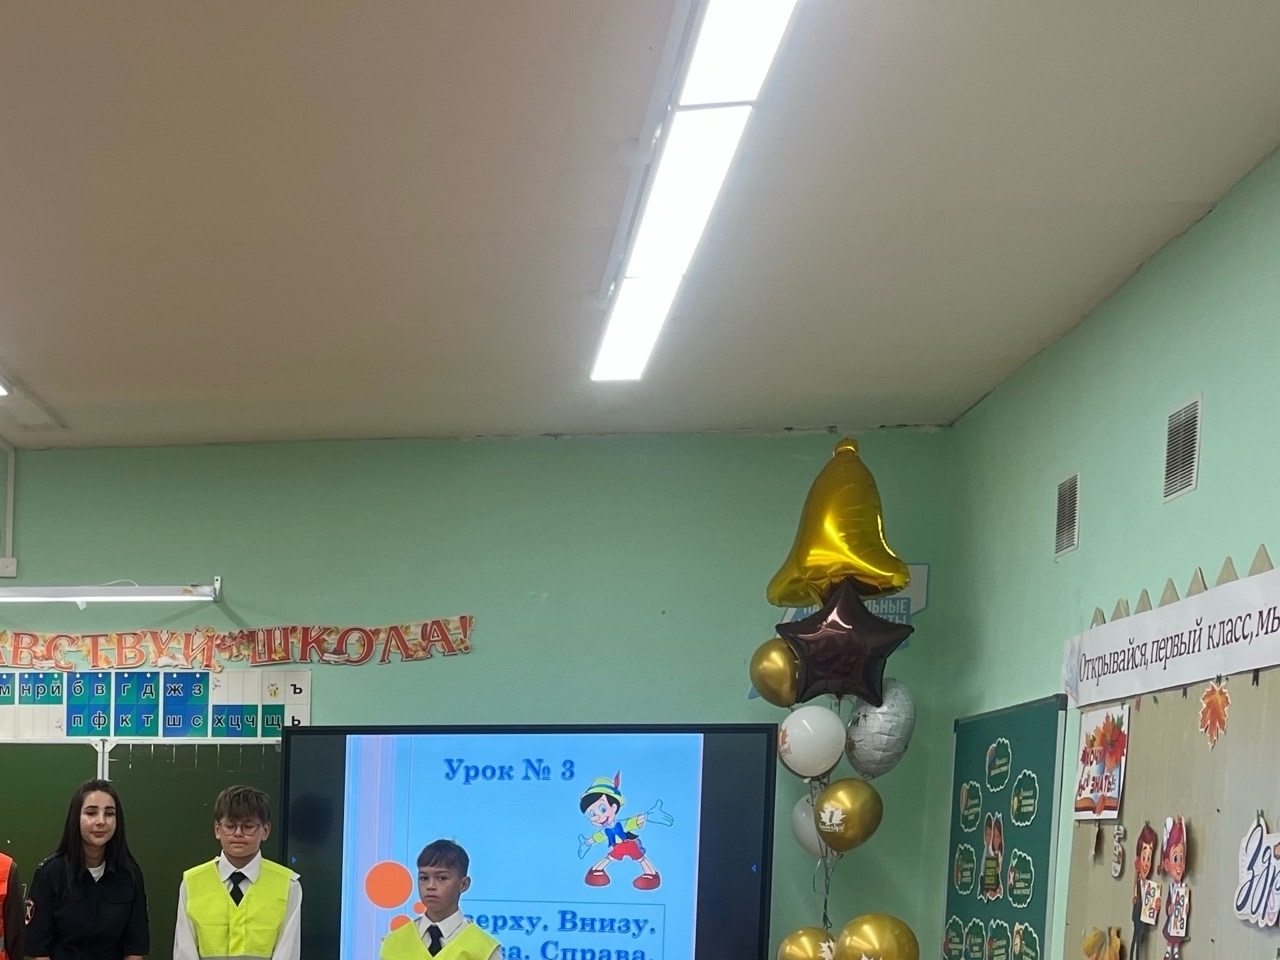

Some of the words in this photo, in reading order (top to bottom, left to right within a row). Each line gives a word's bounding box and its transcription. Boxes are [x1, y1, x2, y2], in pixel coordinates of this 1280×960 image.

[248, 615, 471, 667] ШКОЛА!
[1078, 638, 1149, 686] Открывайся,
[1150, 617, 1203, 670] первый
[1207, 613, 1253, 650] класс,
[443, 758, 514, 785] Урок
[522, 758, 551, 781] №
[561, 759, 576, 781] 3
[463, 913, 549, 936] верху.
[558, 910, 656, 938] Внизу.
